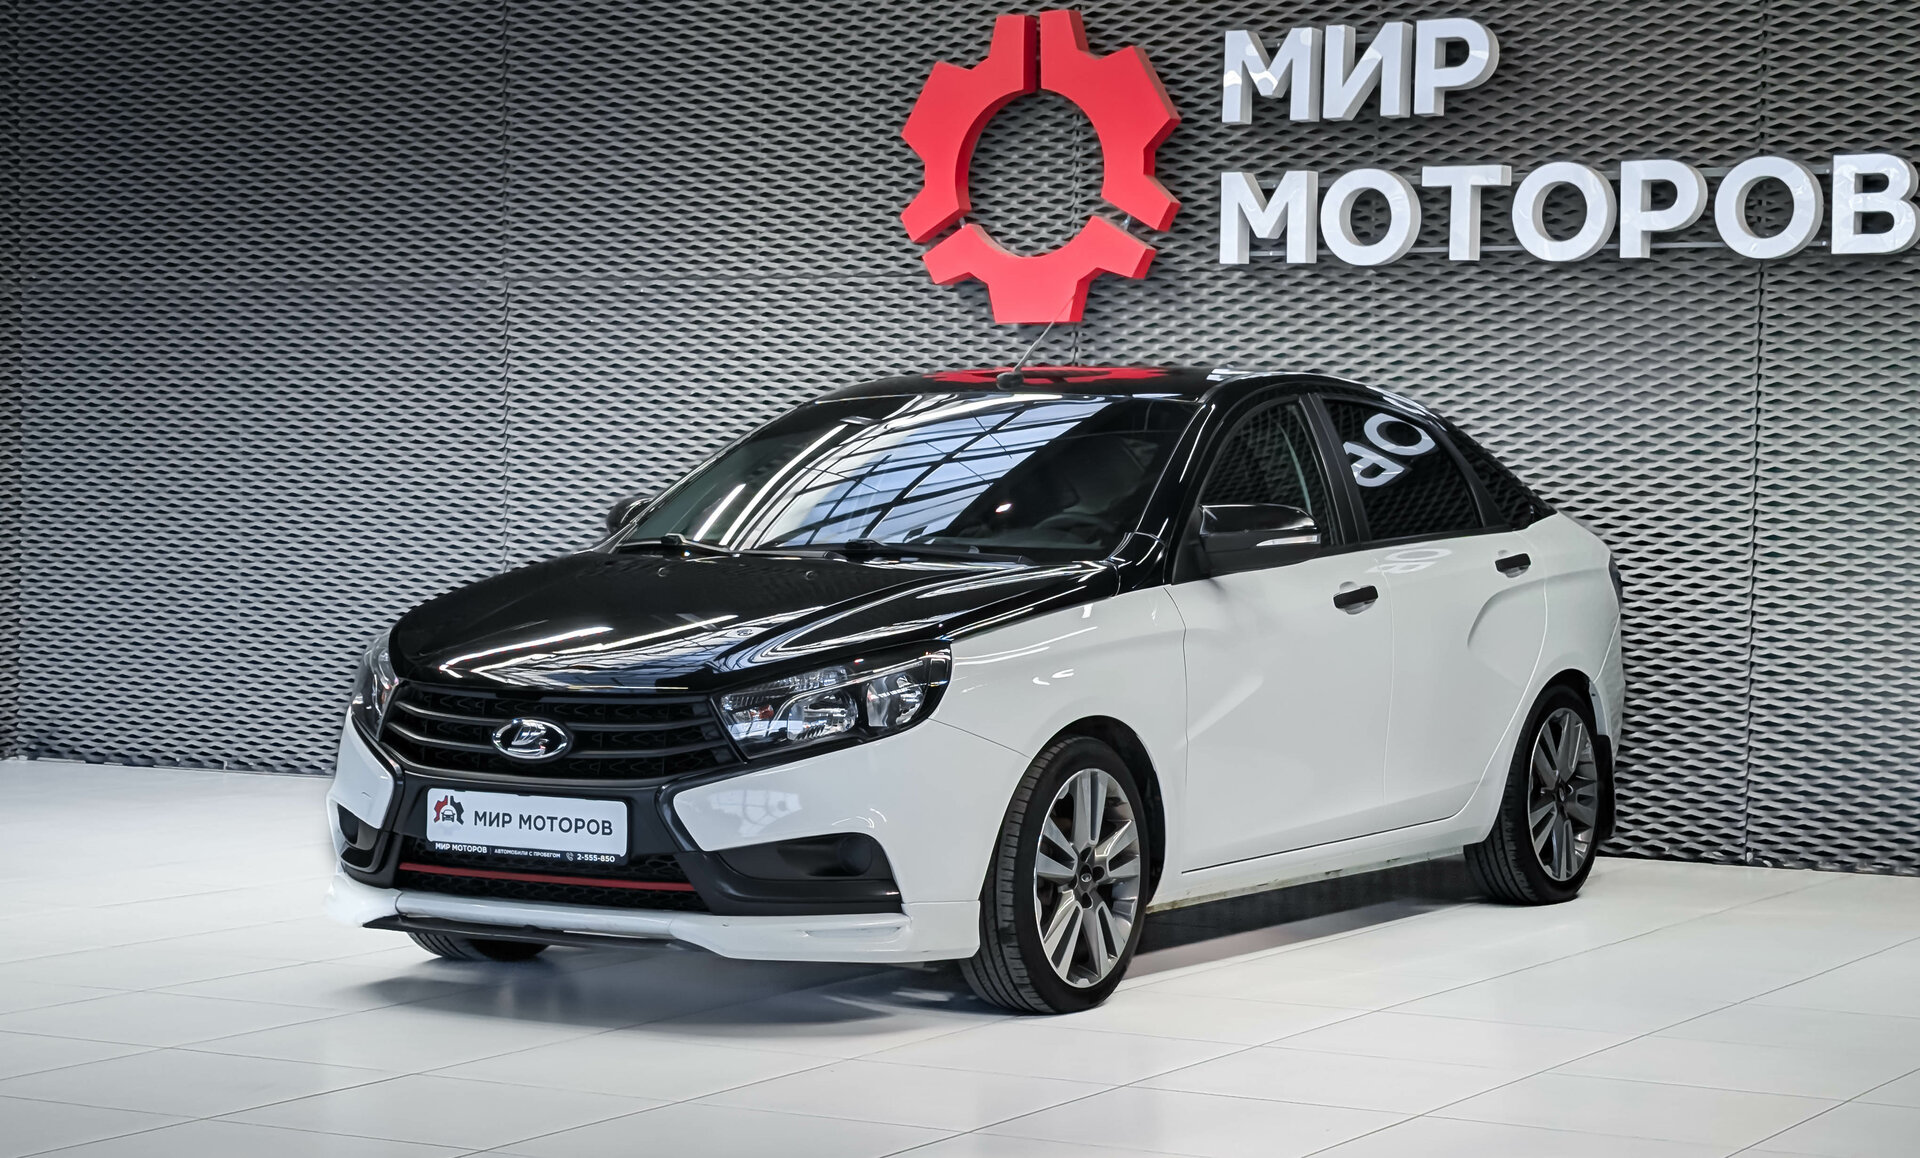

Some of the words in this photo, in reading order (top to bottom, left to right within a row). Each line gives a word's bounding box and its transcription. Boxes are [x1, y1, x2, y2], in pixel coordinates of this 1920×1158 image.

[1221, 17, 1499, 124] МИР
[1219, 153, 1920, 267] МОТОРОВ
[435, 842, 451, 851] МИР
[451, 844, 488, 854] МОТОРОВ
[494, 848, 528, 856] АВТОМОБИЛИ
[533, 851, 561, 859] ПРОБЕГОМ
[576, 853, 616, 863] 2-555-850
[474, 810, 512, 828] МИР
[518, 814, 613, 836] МОТОРОВ
